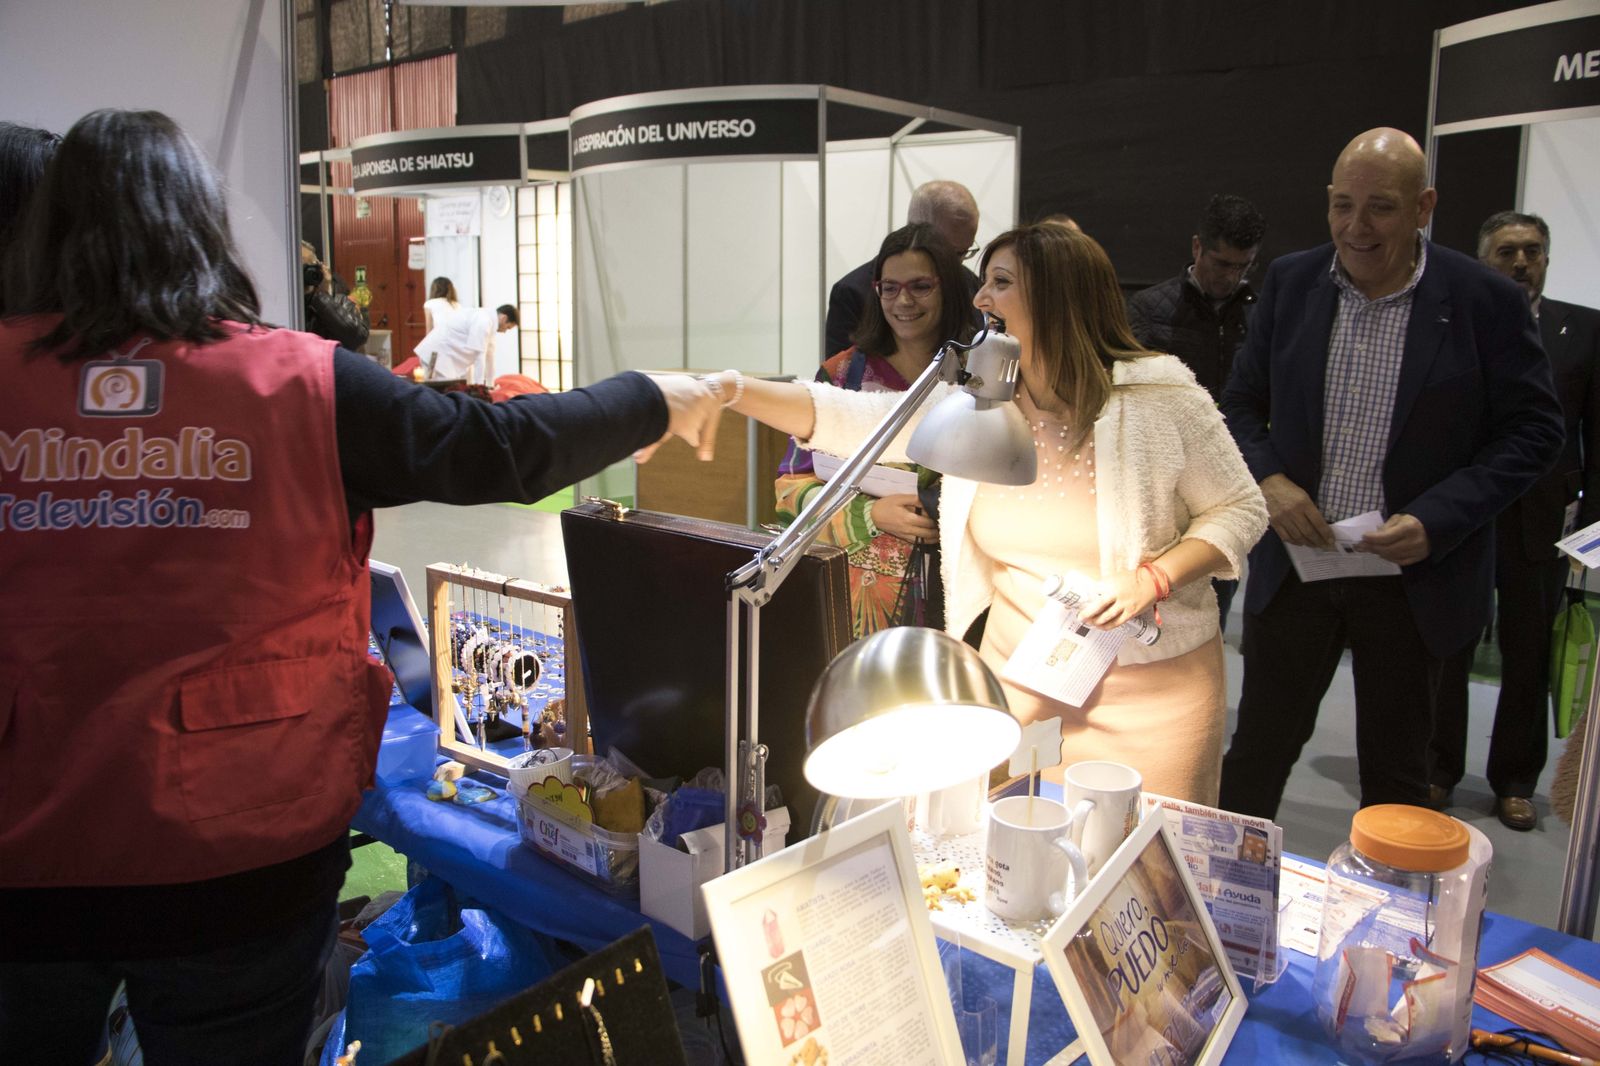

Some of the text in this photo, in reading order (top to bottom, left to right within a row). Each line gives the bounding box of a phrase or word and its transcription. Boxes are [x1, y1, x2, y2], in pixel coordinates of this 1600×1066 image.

[1553, 49, 1600, 83] ME
[578, 124, 636, 153] RESPIRACIÓN
[638, 124, 664, 144] DEL
[667, 118, 756, 142] UNIVERSO
[360, 157, 399, 177] JAPONESA
[400, 156, 415, 173] DE
[416, 151, 474, 171] SHIATSU
[0, 427, 251, 482] Mindalia
[1185, 805, 1217, 818] también
[1219, 813, 1230, 822] en
[1231, 815, 1241, 825] tu
[1242, 818, 1265, 828] móvil
[995, 861, 1009, 871] gota
[1223, 888, 1262, 905] Ayuda
[1100, 897, 1149, 956] Quiero,
[1106, 915, 1169, 1013] PUEDO
